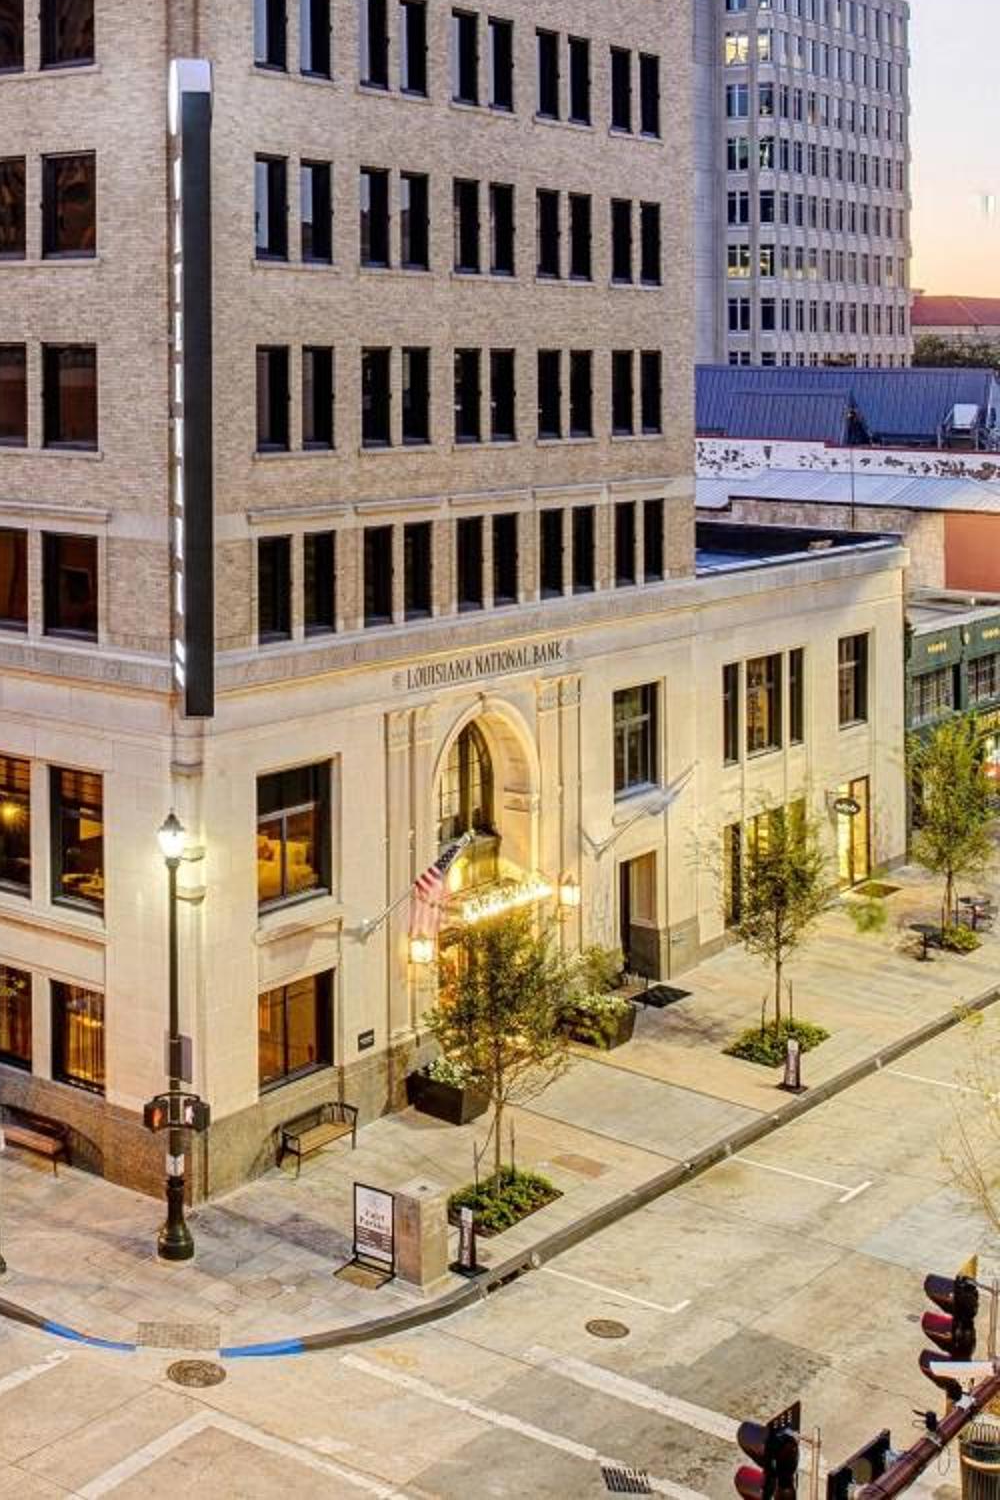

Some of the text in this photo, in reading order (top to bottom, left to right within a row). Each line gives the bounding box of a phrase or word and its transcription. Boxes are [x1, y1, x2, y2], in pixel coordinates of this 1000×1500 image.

[407, 641, 563, 689] LOUISIANA NATIONAL BANK
